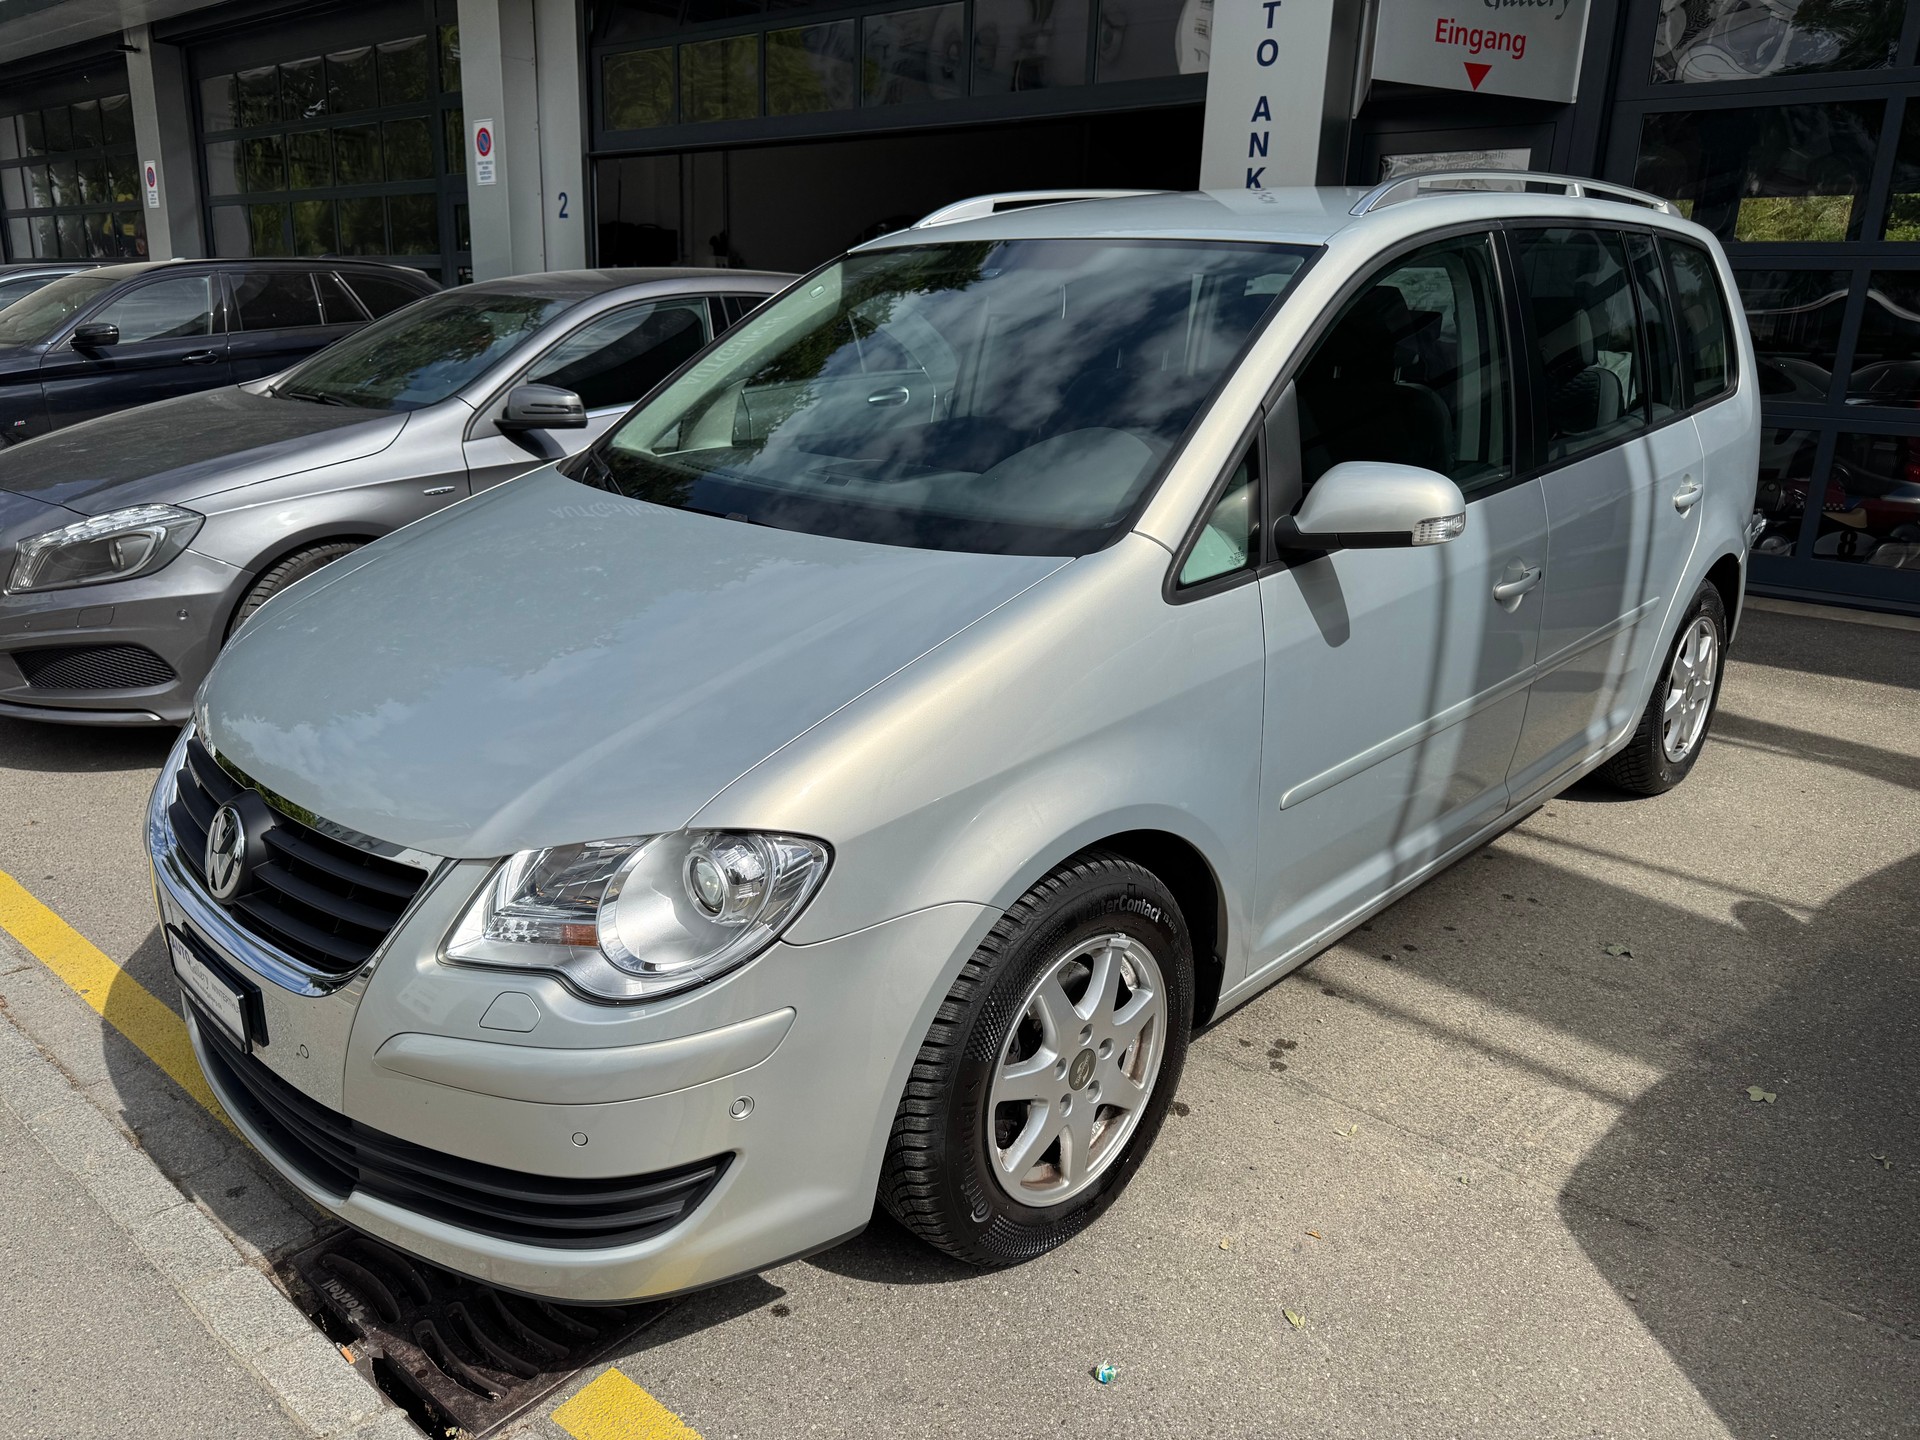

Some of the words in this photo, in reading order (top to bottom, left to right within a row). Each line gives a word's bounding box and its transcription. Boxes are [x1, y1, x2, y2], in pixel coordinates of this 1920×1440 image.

[1434, 18, 1527, 60] Eingang
[558, 191, 569, 219] 2
[1837, 530, 1858, 558] 8
